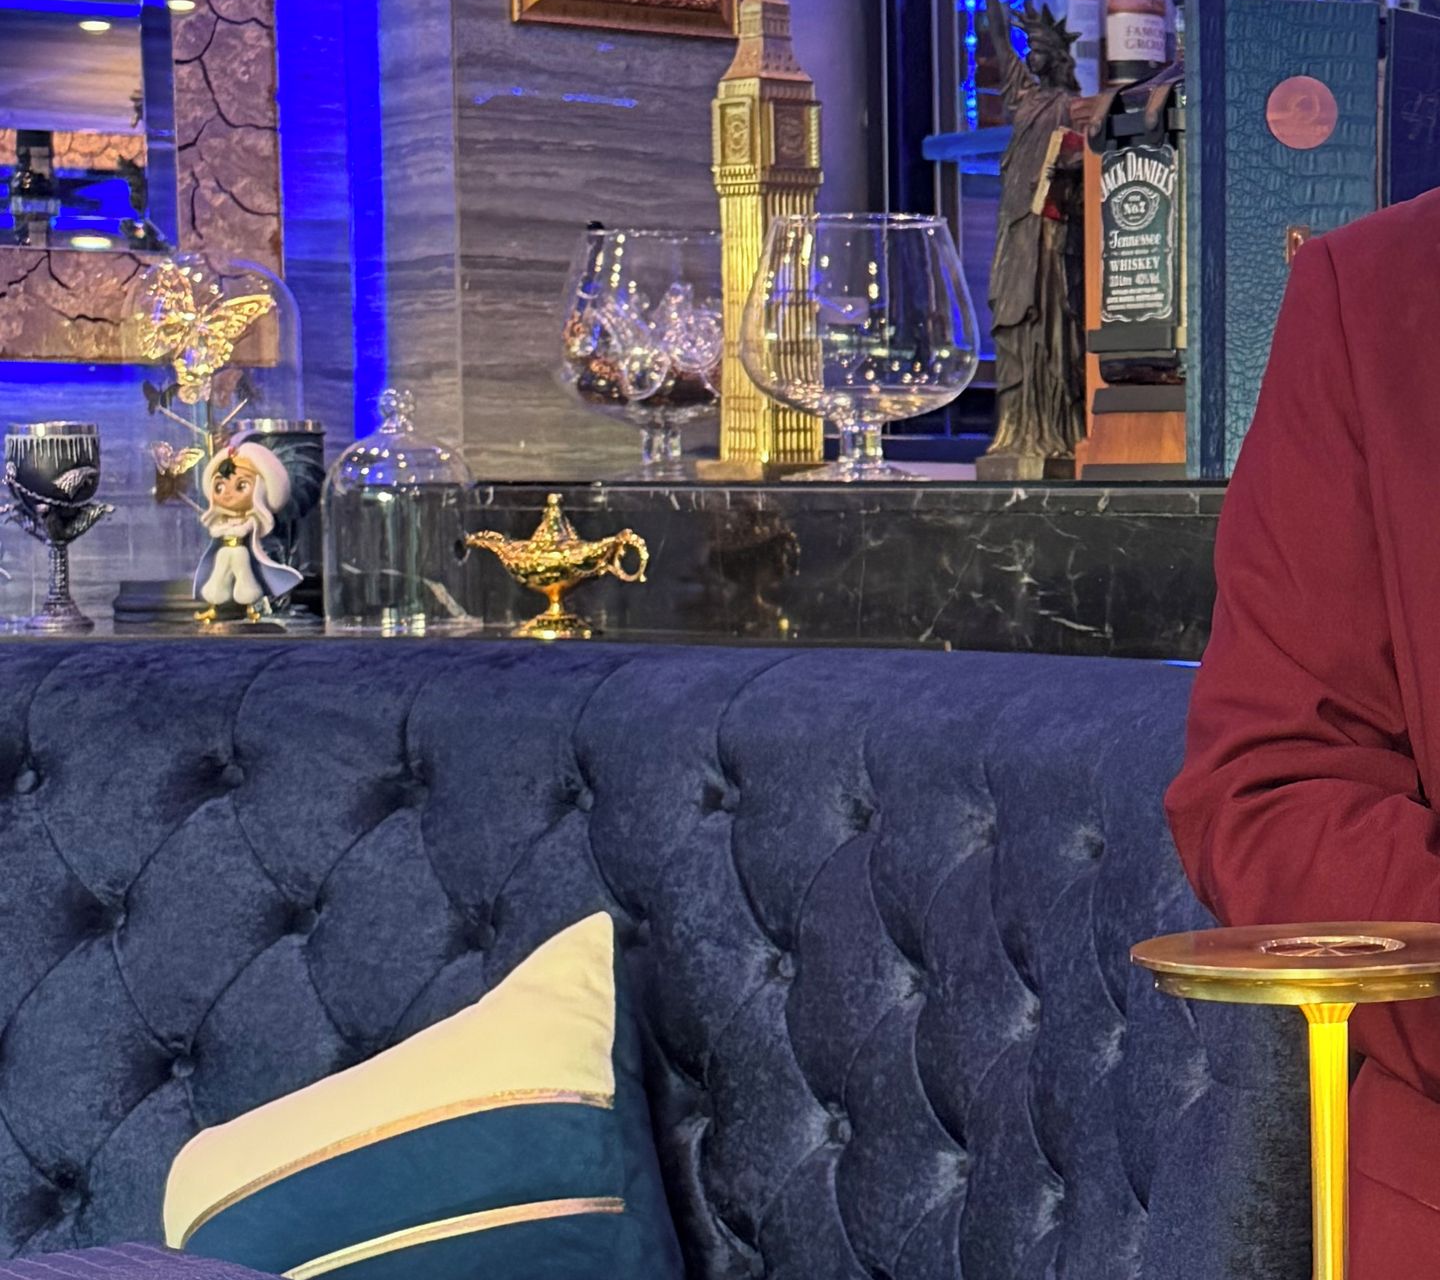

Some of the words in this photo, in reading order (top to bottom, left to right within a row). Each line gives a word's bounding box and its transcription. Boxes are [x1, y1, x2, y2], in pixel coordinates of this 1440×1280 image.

[1100, 160, 1127, 202] JACK
[1126, 151, 1175, 196] DANIEL'S
[1109, 230, 1162, 249] Tennessee
[1109, 256, 1160, 272] WHISKEY
